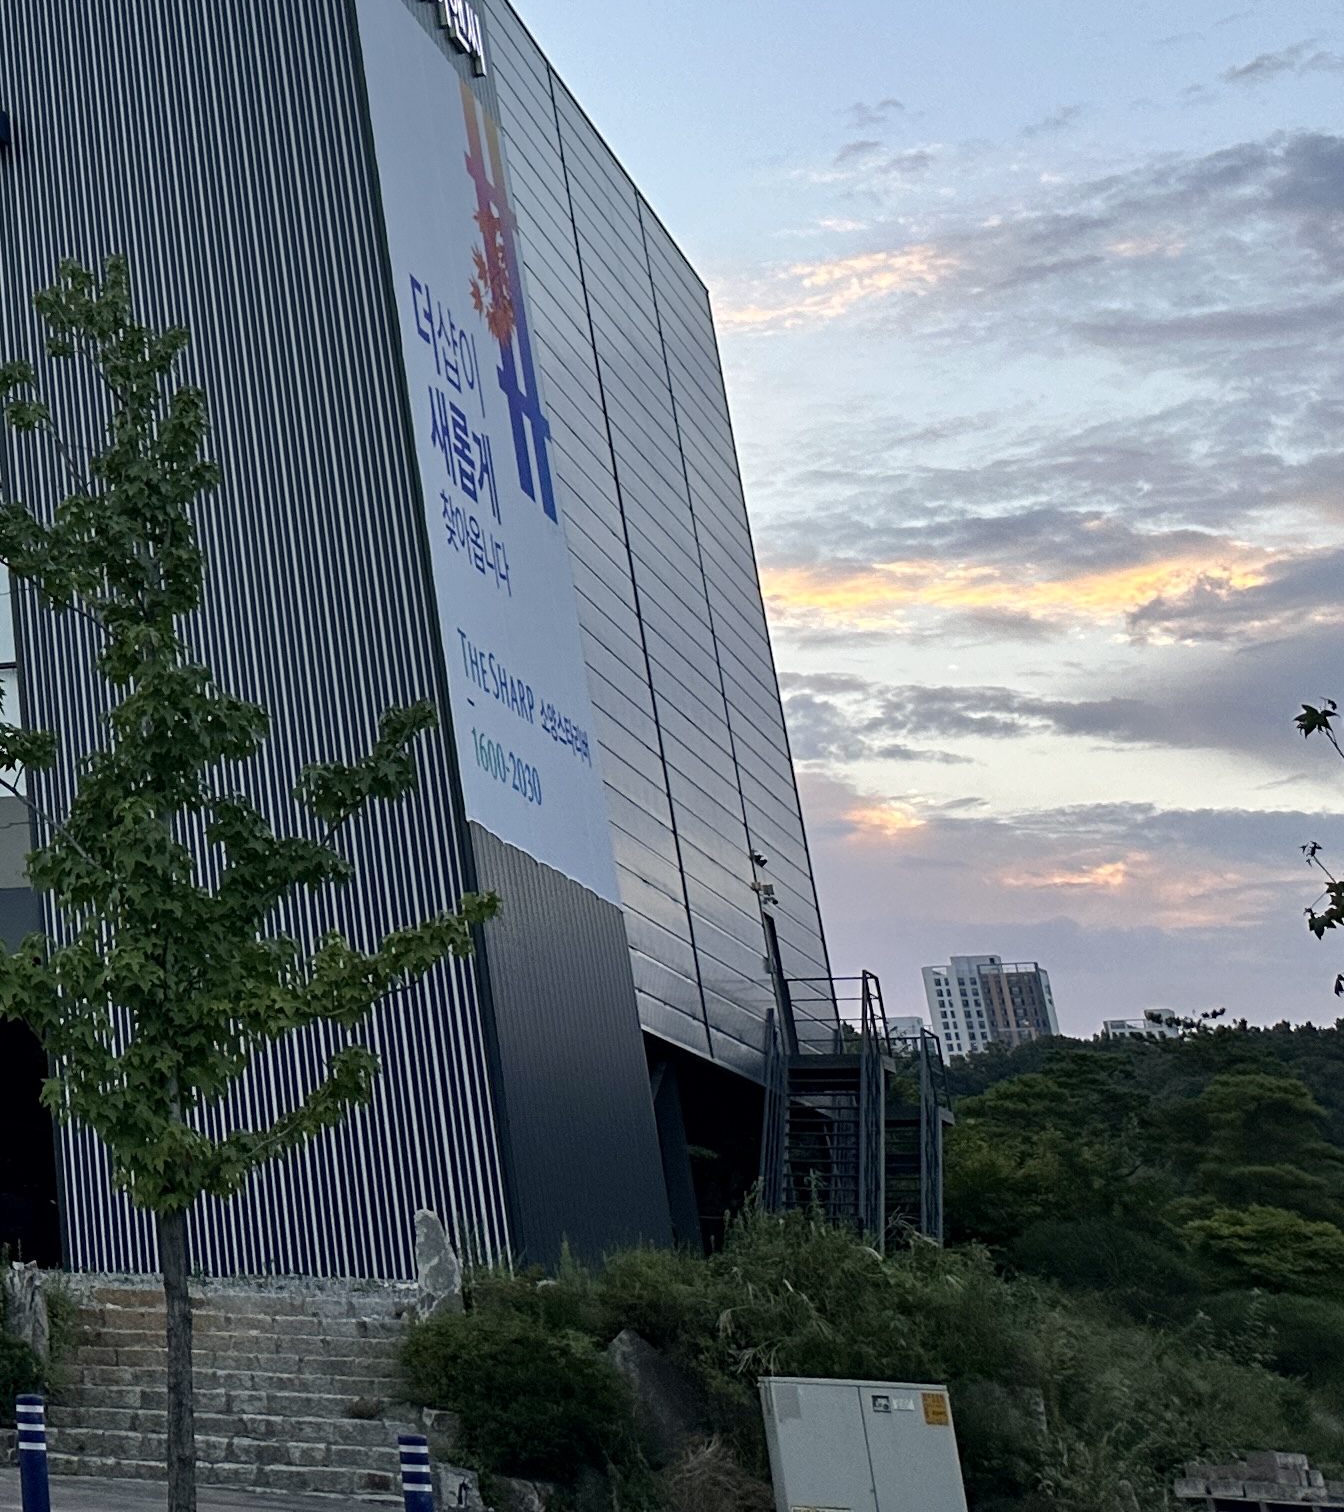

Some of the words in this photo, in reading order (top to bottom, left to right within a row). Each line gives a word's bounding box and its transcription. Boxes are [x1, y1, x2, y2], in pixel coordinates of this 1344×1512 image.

[409, 273, 486, 418] 더샵이
[428, 385, 501, 525] 새롭게
[439, 488, 512, 597] 찾아옵니다
[457, 627, 490, 693] THE
[488, 652, 534, 724] SHARP
[540, 699, 592, 768] 소양스타리버
[472, 726, 542, 805] 1600-2030
